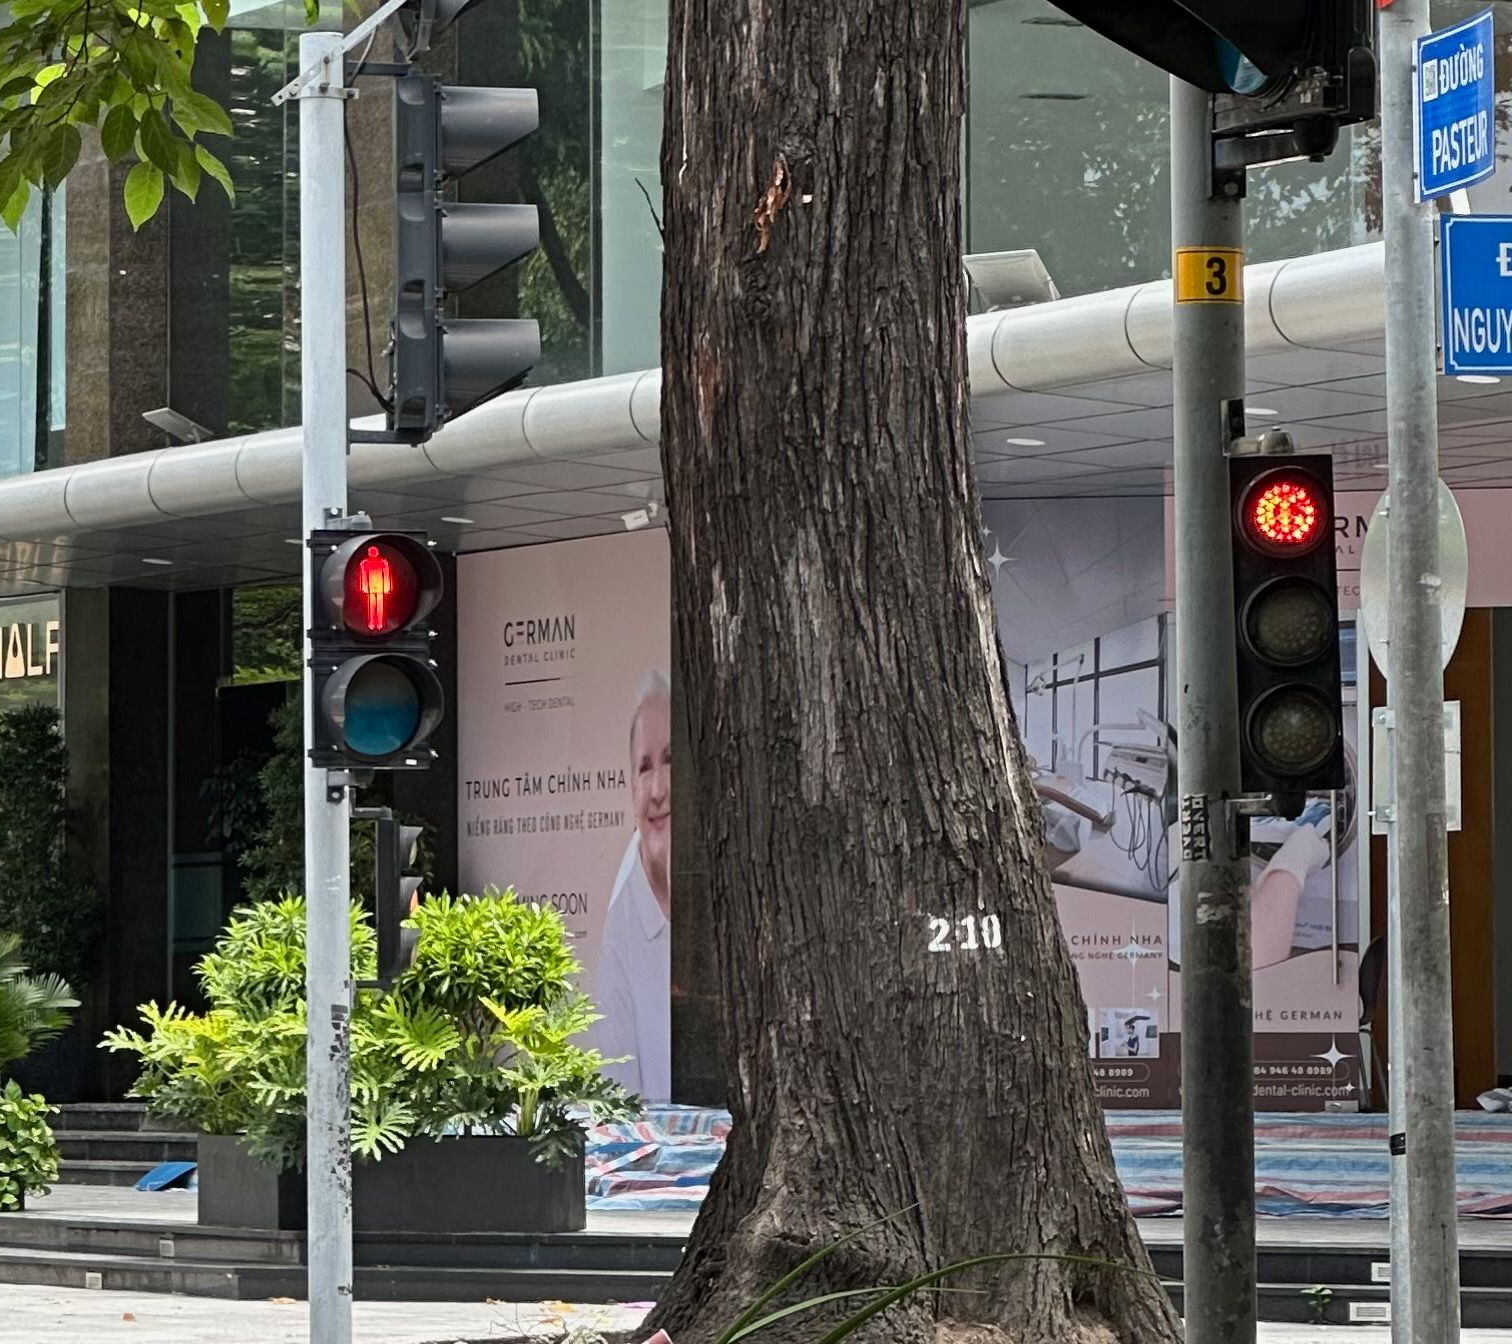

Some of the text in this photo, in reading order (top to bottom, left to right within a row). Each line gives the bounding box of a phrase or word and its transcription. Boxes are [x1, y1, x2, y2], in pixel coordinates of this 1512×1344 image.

[1439, 43, 1484, 95] ĐƯỜNG
[1432, 110, 1488, 176] PASTEUR
[1205, 257, 1227, 295] 3
[504, 614, 575, 647] GERMAN
[504, 647, 575, 666] DENTAL CLINIC
[465, 778, 510, 800] TRUNG
[515, 772, 542, 796] TÂM
[597, 769, 626, 789] NHA
[587, 811, 626, 829] GERMANY
[552, 892, 588, 916] SOON
[928, 914, 1002, 952] 210
[1129, 935, 1163, 946] NHA
[1280, 1010, 1342, 1021] GERMAN
